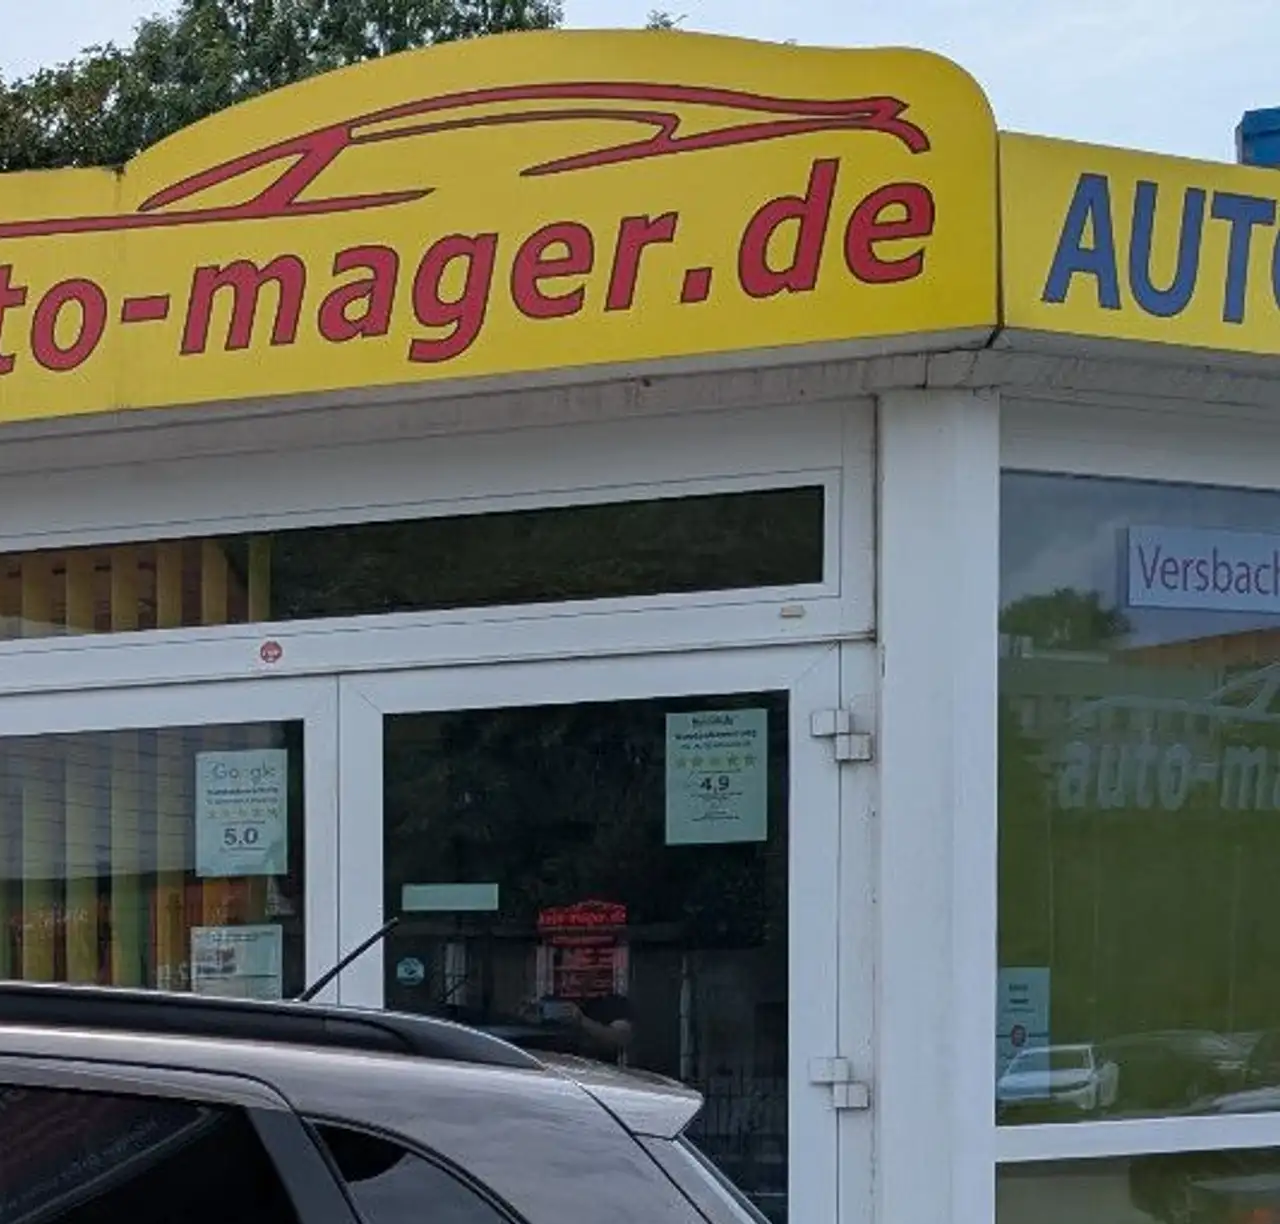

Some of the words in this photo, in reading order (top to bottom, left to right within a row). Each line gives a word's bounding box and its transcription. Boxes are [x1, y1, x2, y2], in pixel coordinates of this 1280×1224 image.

[1041, 172, 1280, 323] AUT
[1058, 728, 1280, 810] auto-m
[223, 827, 259, 846] 5.0
